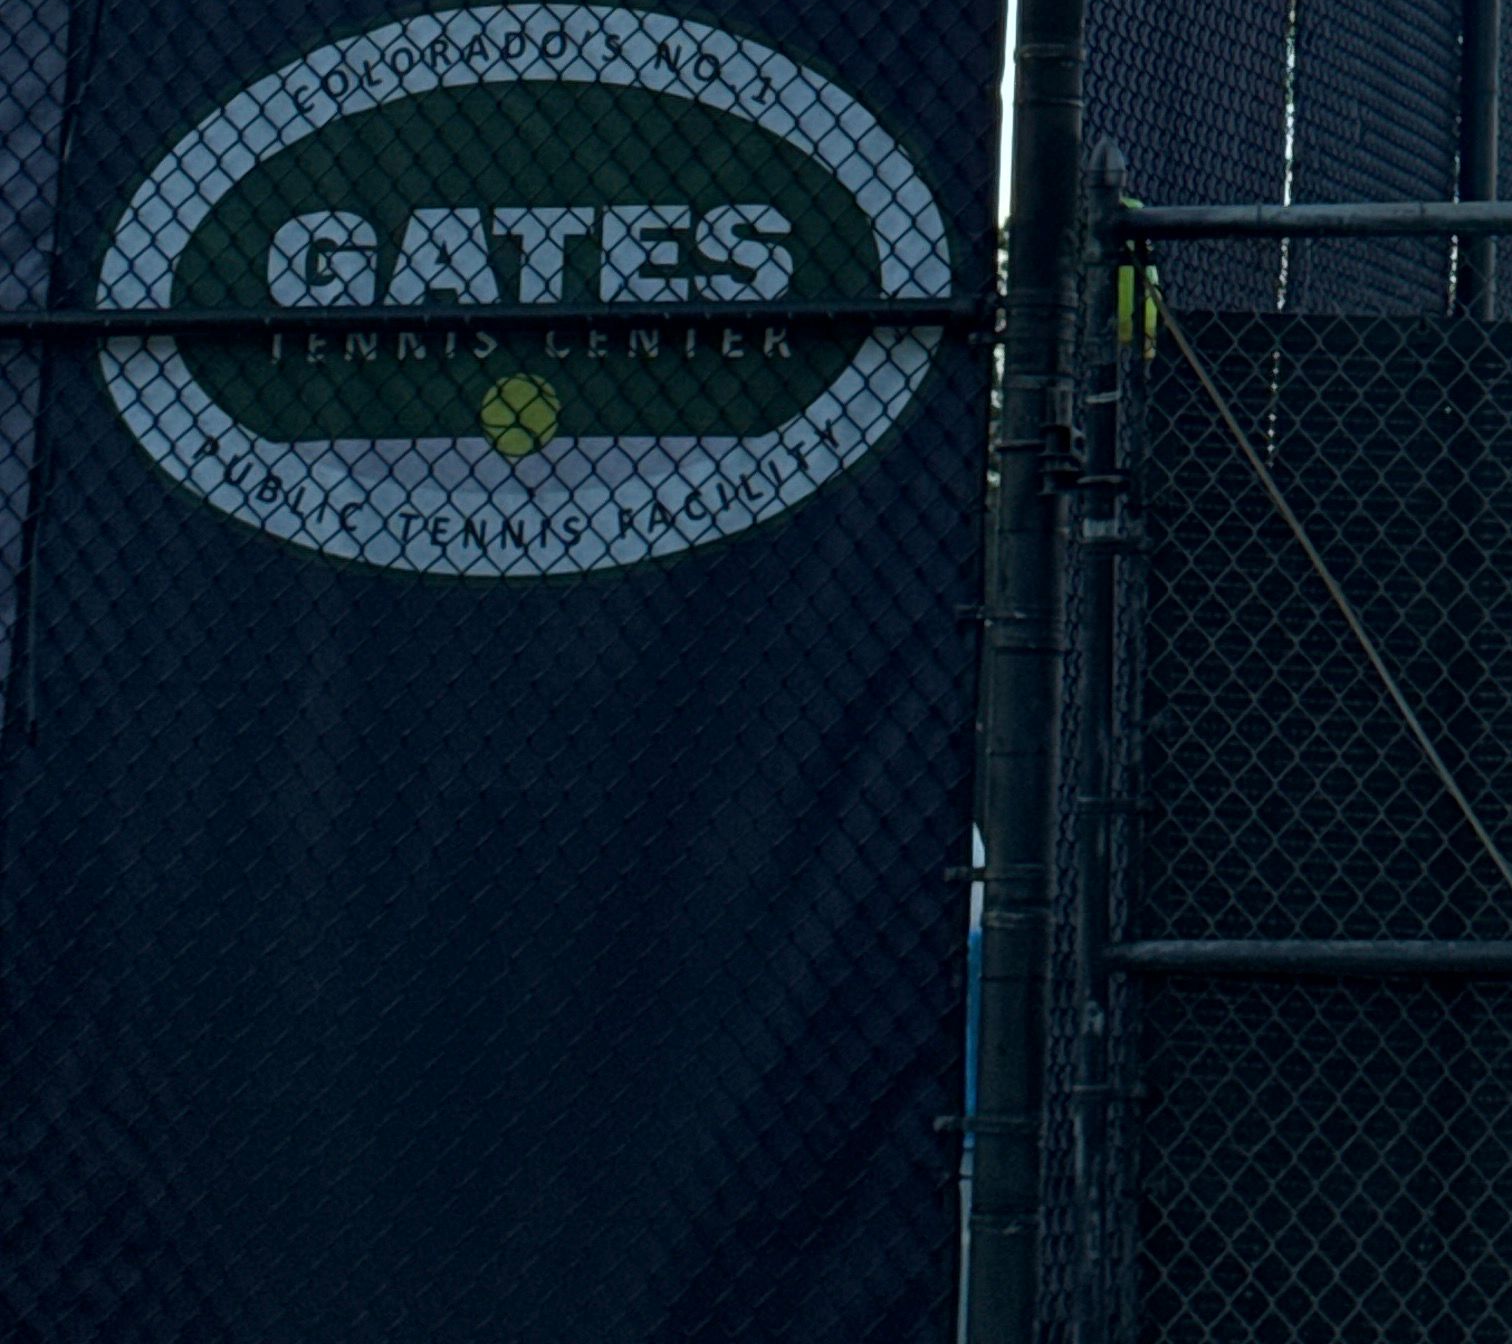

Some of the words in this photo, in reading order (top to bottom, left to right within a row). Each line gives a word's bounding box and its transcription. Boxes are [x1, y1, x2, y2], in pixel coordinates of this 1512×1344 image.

[292, 29, 623, 115] COLORADO'S
[267, 203, 795, 308] GATES
[192, 434, 365, 534] PUBLIC
[398, 511, 583, 549] TENNIS
[616, 418, 842, 540] FACILITY
